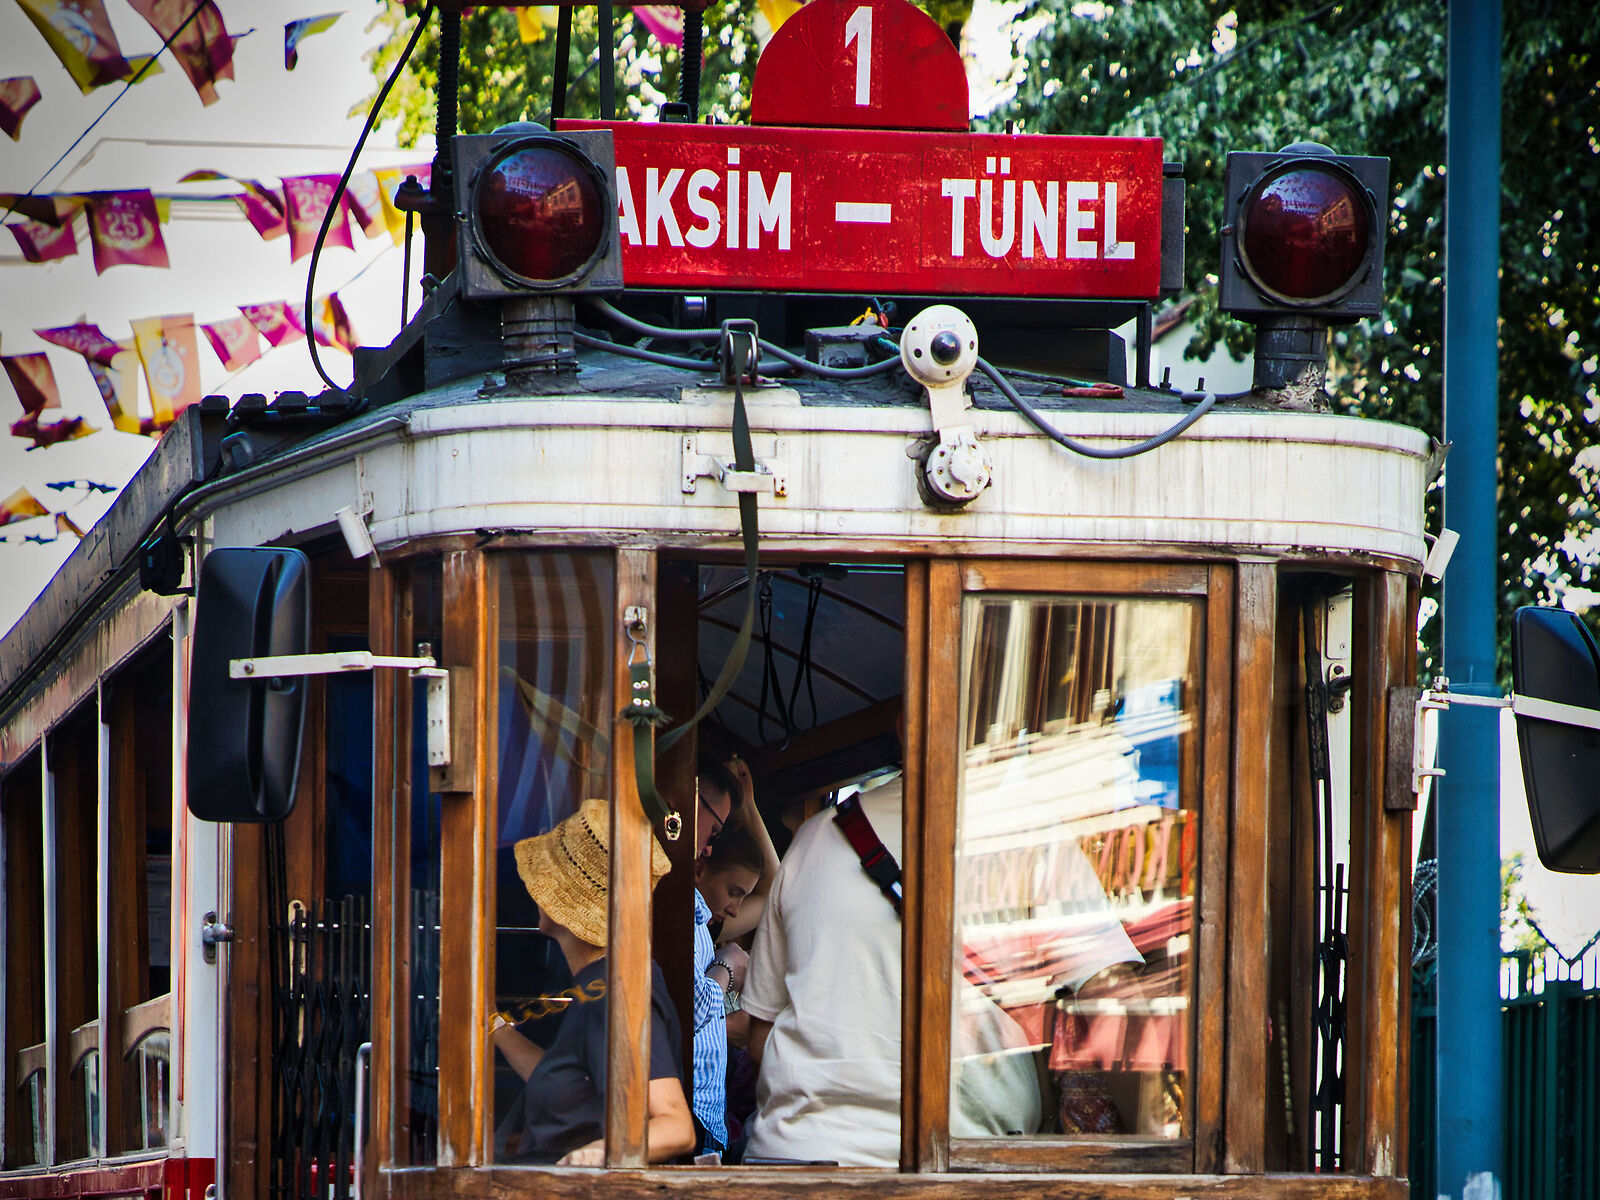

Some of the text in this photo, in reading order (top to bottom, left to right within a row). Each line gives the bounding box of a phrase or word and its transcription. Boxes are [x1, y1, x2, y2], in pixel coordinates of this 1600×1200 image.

[844, 6, 873, 106] 1
[106, 211, 140, 238] 25
[616, 147, 792, 250] AKSİM
[941, 156, 1136, 260] TÜNEL
